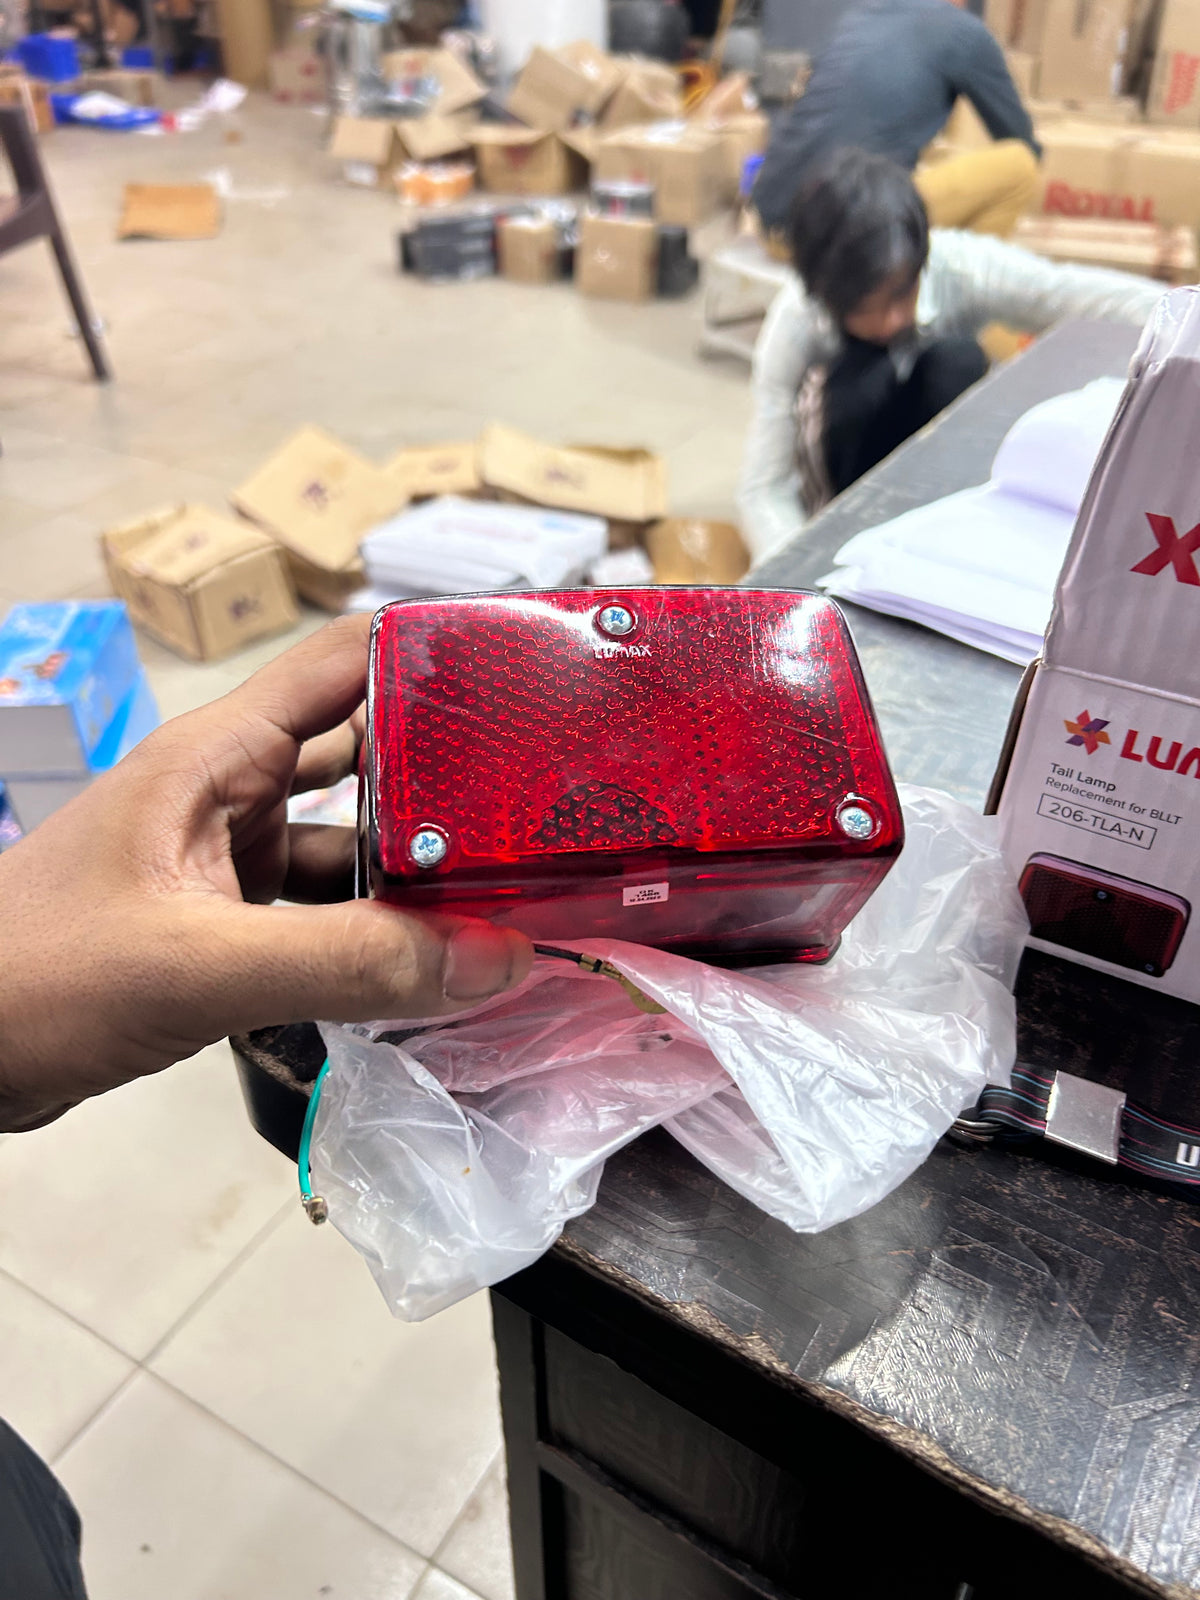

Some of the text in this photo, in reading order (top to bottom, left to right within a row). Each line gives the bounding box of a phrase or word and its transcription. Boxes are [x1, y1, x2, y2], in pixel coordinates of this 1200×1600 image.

[1042, 178, 1155, 222] ROYAL
[1129, 512, 1200, 588] X
[1050, 762, 1117, 793] Tail Lamp
[1045, 776, 1183, 826] Replacement for BLLT
[1048, 801, 1145, 841] 206-TLA-N
